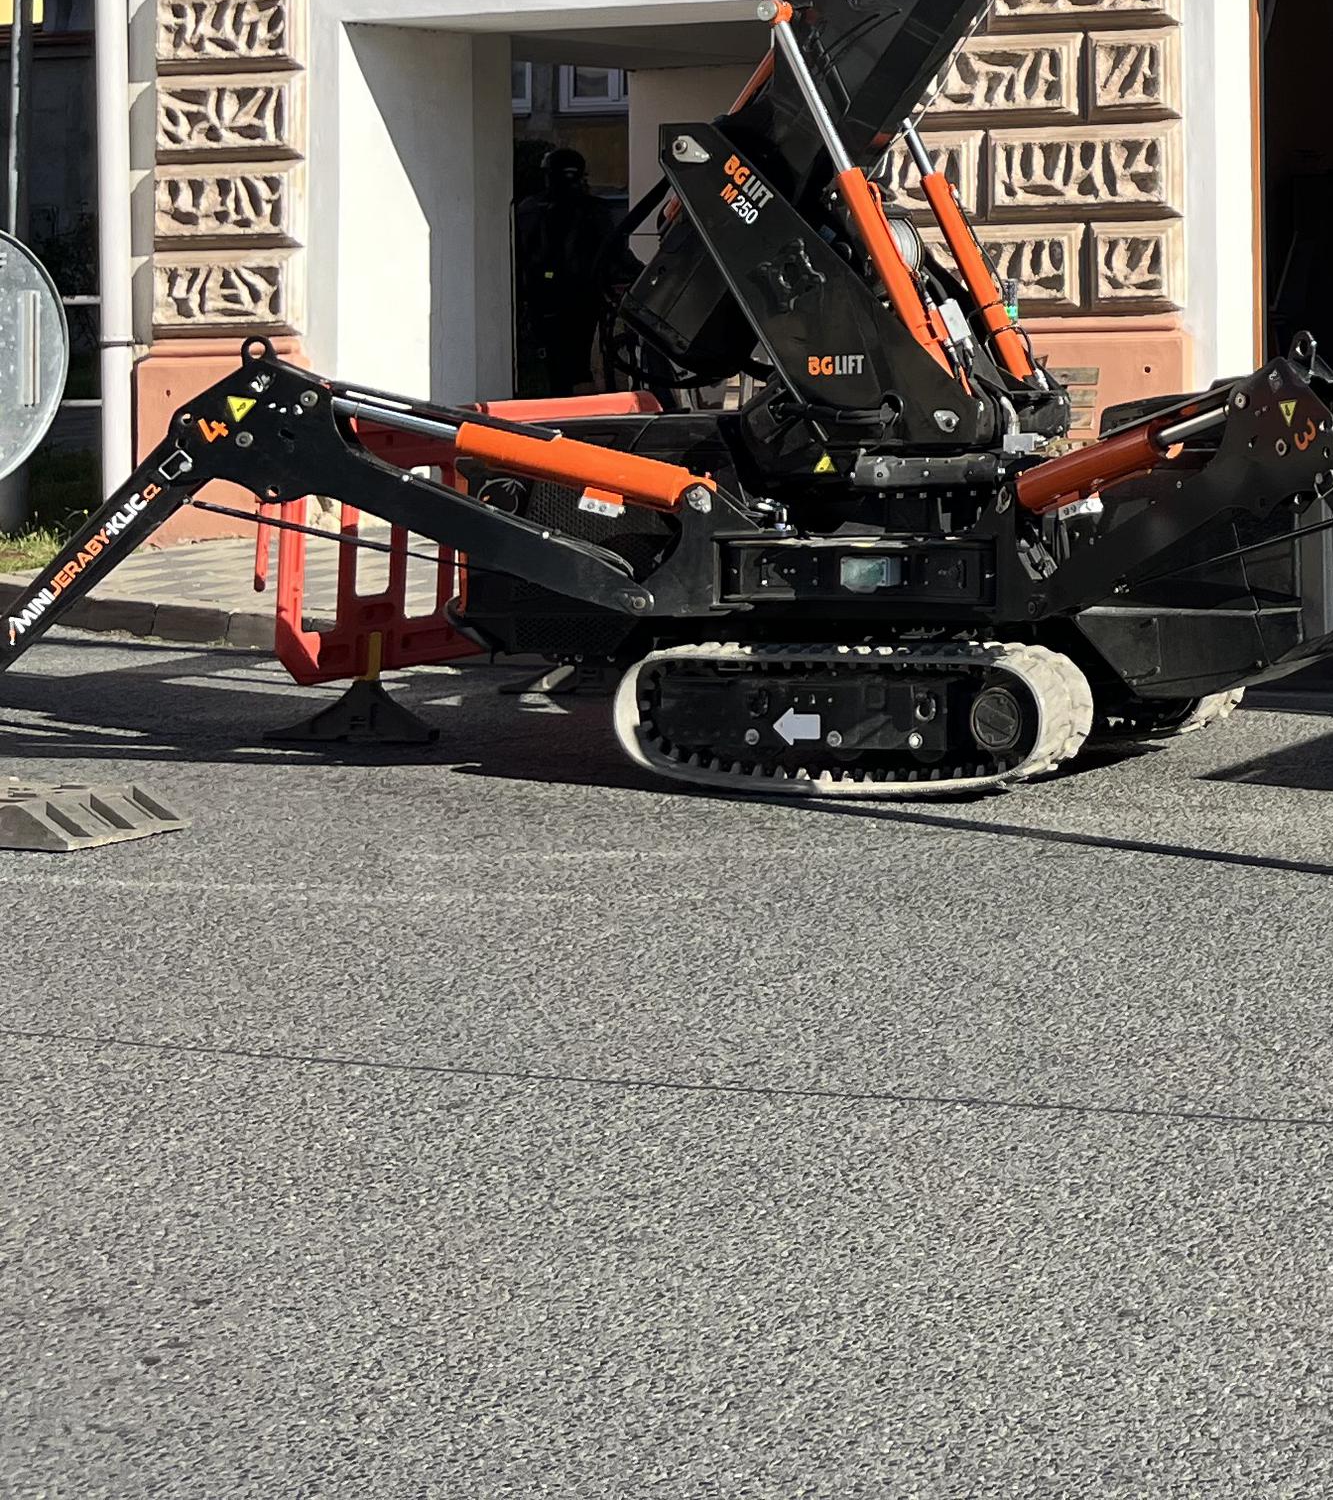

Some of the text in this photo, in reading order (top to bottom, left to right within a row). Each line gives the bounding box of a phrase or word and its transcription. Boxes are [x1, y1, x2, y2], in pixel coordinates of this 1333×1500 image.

[720, 183, 758, 224] M250
[198, 418, 229, 443] 4
[1294, 417, 1316, 451] 3
